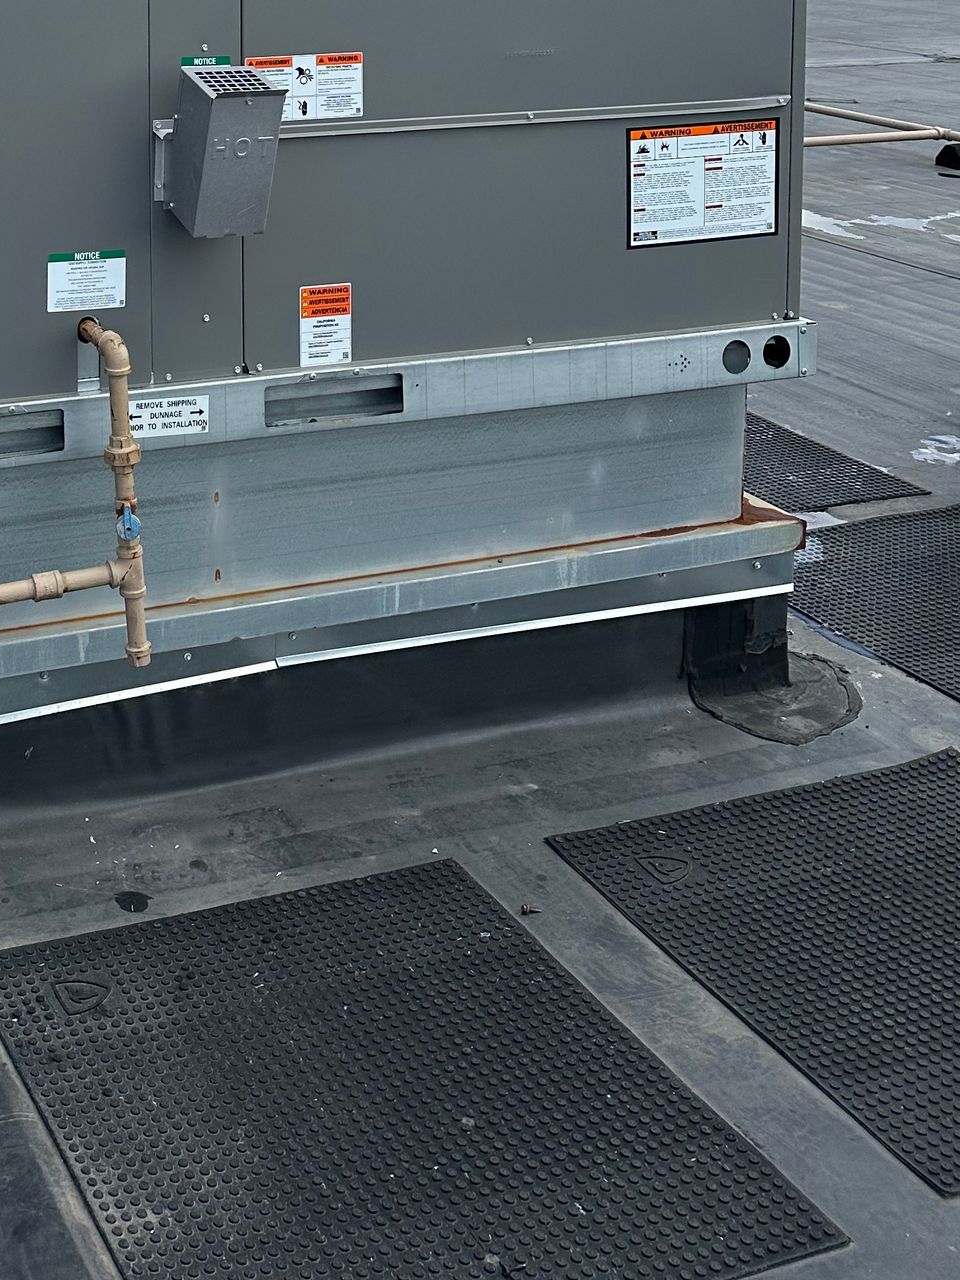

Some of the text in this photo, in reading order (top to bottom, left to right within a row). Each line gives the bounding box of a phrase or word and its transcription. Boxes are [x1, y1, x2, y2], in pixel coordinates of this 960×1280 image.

[193, 57, 217, 66] NOTICE
[720, 121, 773, 132] AVERTISSEMENT
[650, 128, 692, 138] WARNING
[210, 136, 274, 160] HOT
[74, 251, 101, 260] NOTICE
[308, 287, 349, 296] WARNING
[308, 297, 349, 305] AVERTISSEMENT
[311, 306, 348, 315] ADVERTENCIA
[136, 399, 197, 410] REMOVE SHIPPING
[150, 410, 183, 420] DUNNAGE
[162, 418, 208, 429] INSTALLATION
